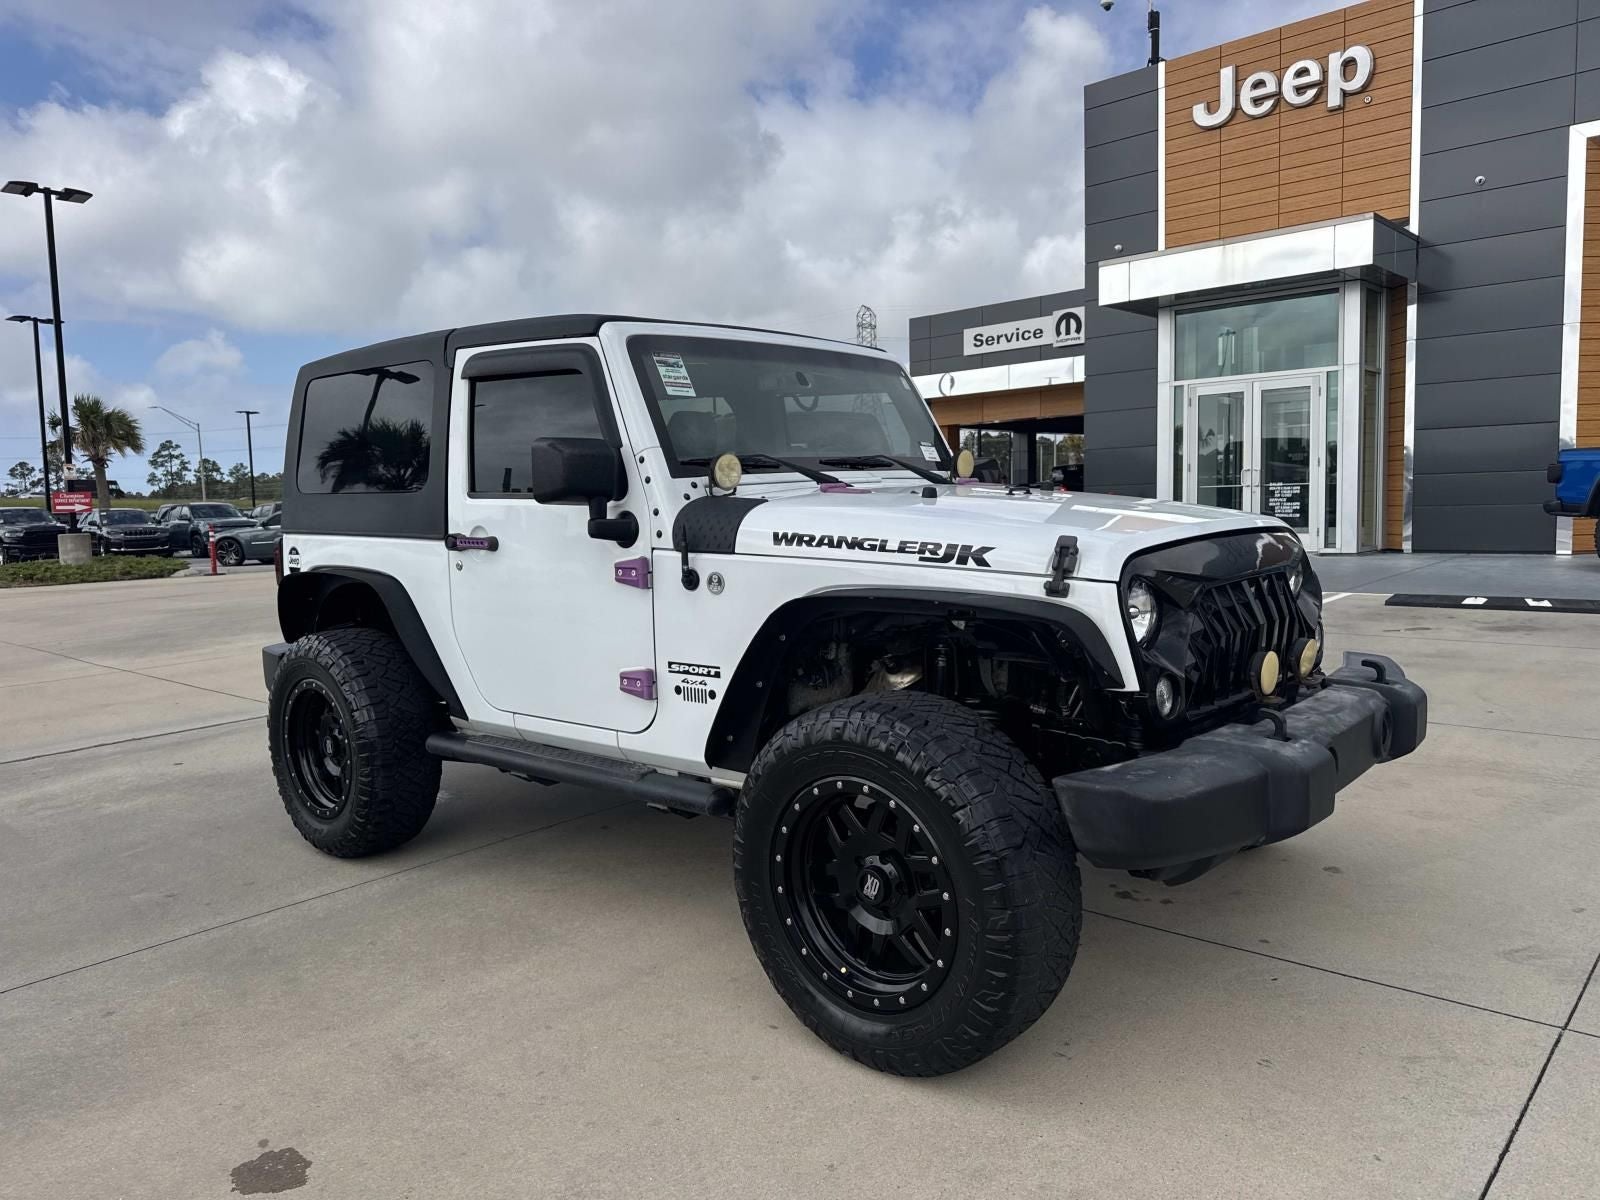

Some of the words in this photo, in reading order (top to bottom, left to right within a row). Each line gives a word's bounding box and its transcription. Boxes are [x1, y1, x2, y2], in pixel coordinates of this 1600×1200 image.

[1192, 44, 1375, 131] Jeep
[973, 327, 1044, 348] Service
[668, 664, 720, 676] SPORT
[681, 678, 707, 686] 4x4
